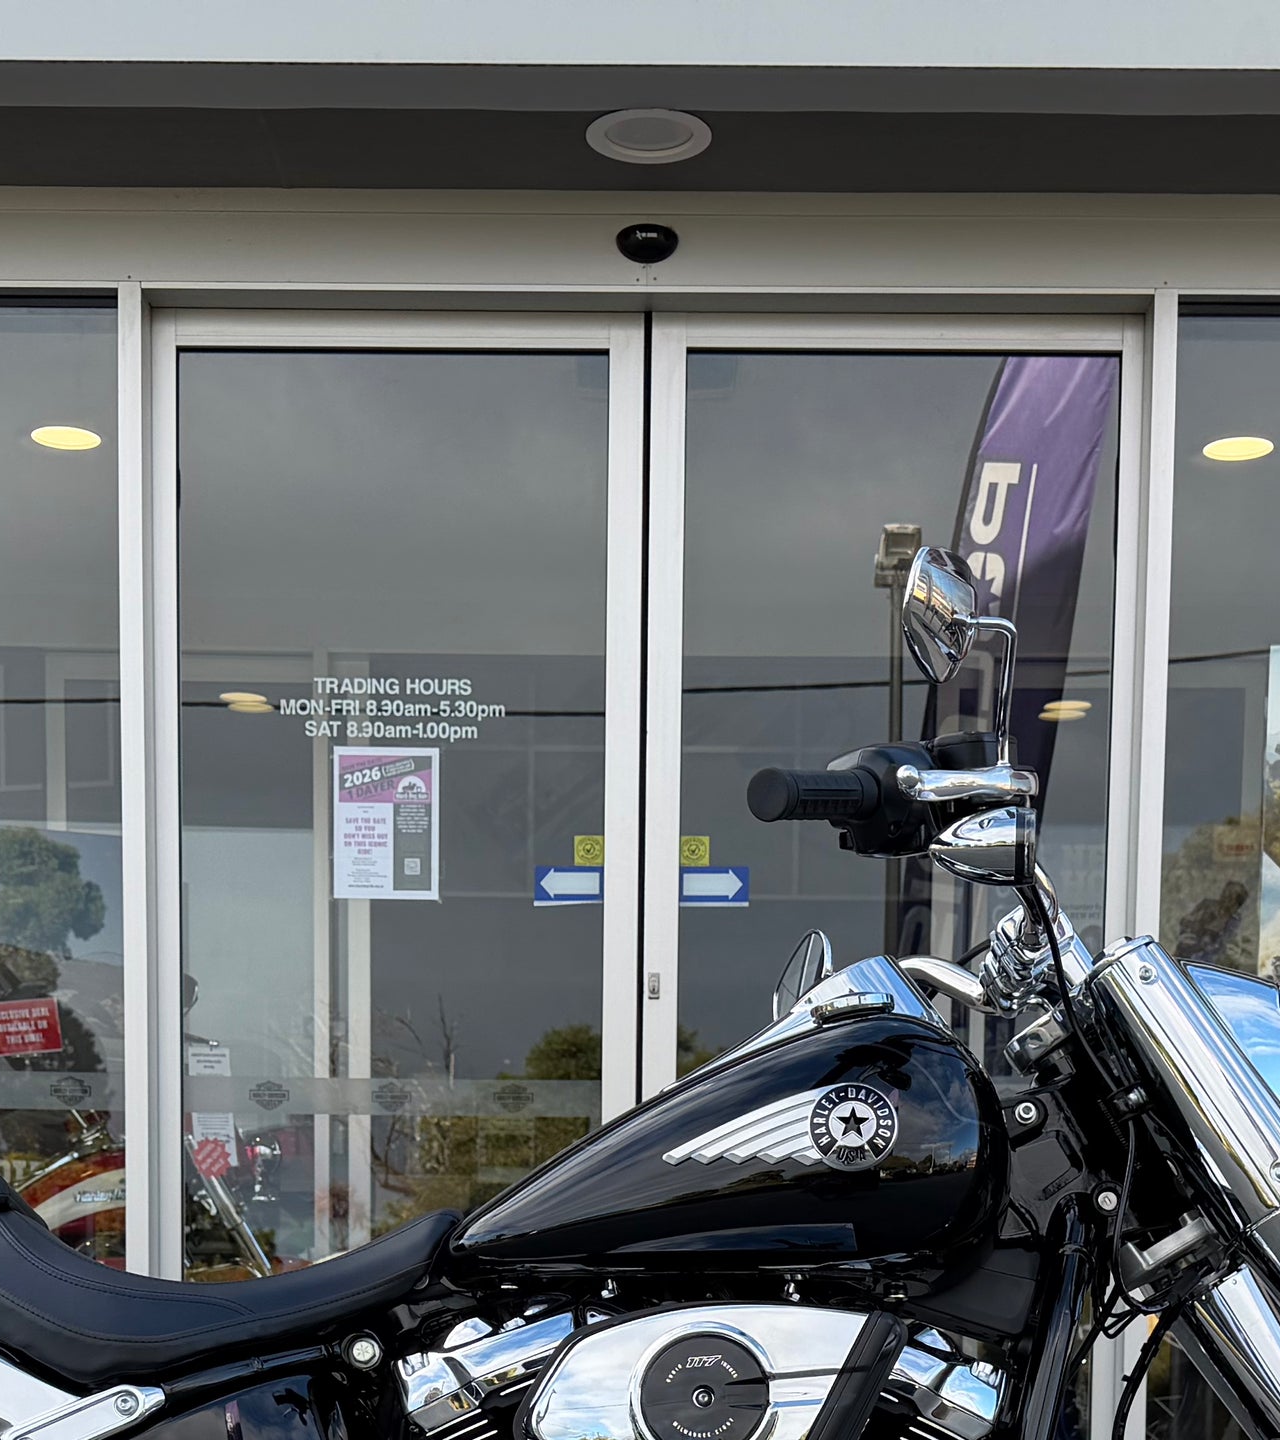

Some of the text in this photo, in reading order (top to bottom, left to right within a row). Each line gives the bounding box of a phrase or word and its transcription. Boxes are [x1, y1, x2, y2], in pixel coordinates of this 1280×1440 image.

[314, 677, 472, 696] TRADING HOURS
[280, 698, 506, 721] MON-FRI 8.30am-5.30pm
[304, 721, 478, 742] SAT 8.30am-1.00pm
[343, 766, 381, 788] 2026
[355, 780, 396, 798] DAYER
[810, 1086, 893, 1148] HARLEY-DAVIDSON
[686, 1354, 723, 1368] 117
